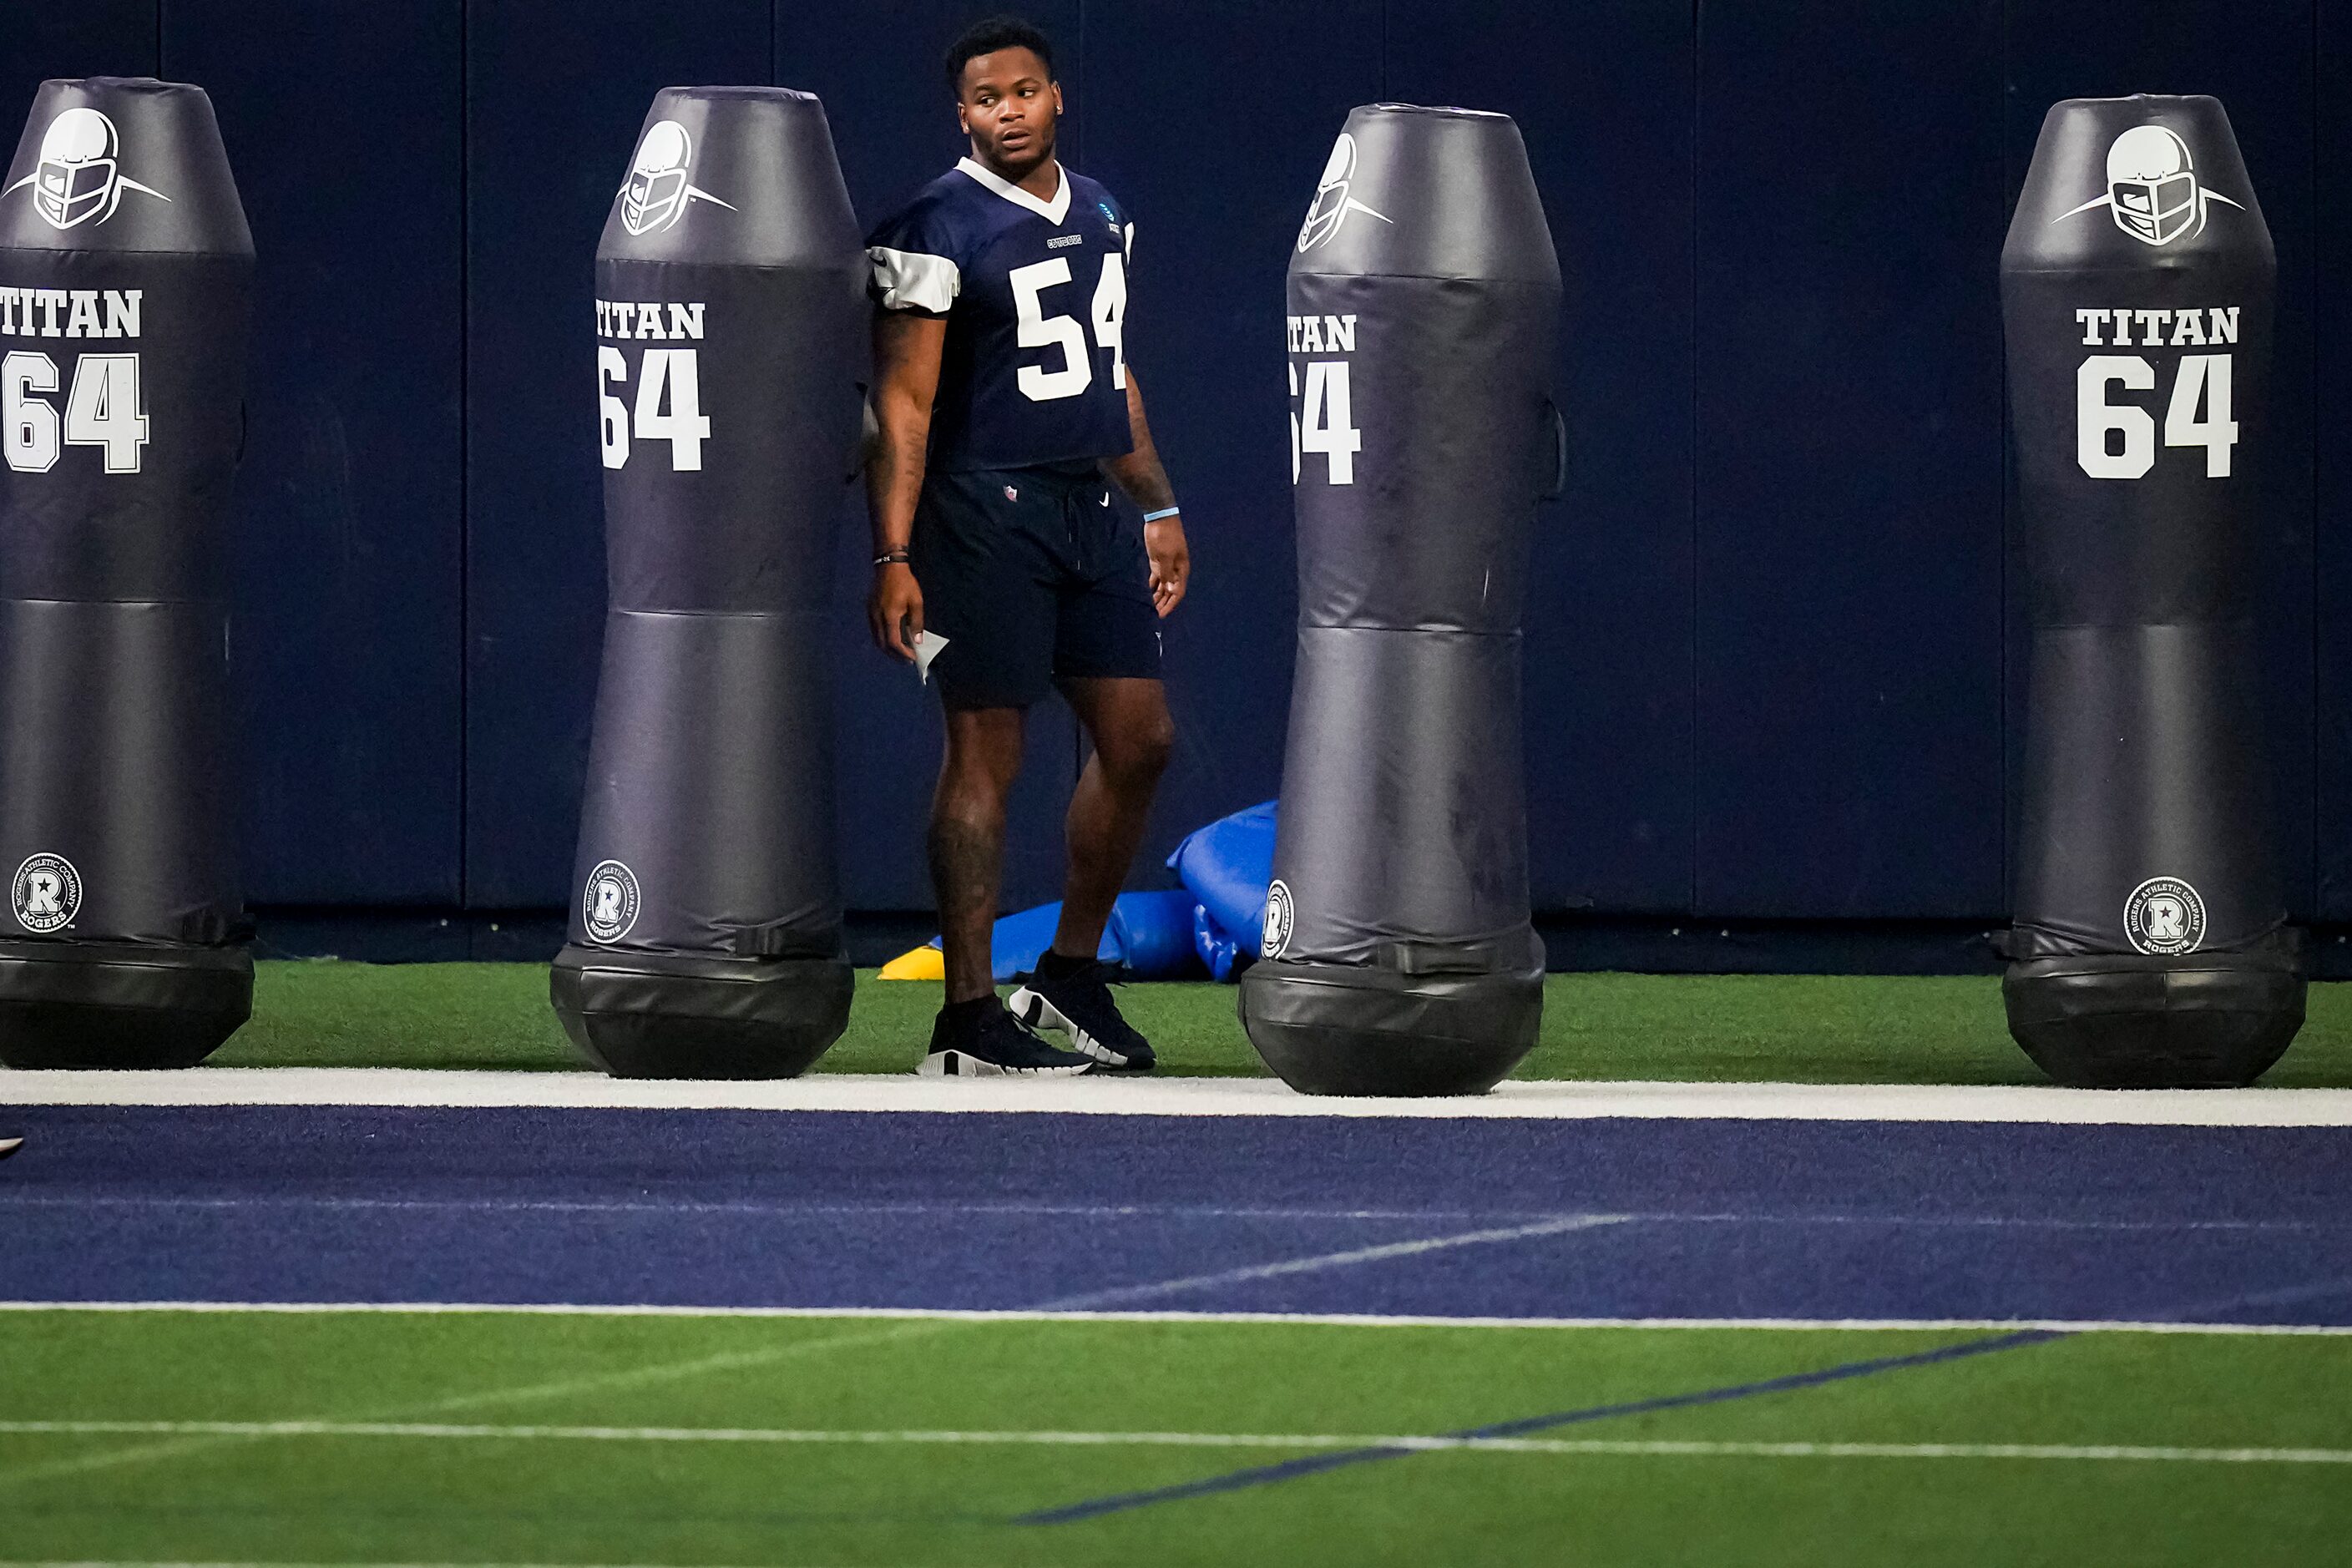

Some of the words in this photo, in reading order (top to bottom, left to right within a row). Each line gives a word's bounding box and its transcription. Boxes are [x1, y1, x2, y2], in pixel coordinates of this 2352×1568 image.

[0, 286, 142, 337] TITAN
[595, 299, 706, 339] TITAN
[1009, 252, 1127, 402] 54
[2076, 306, 2240, 346] TITAN
[2, 350, 150, 474] 64
[597, 345, 711, 471] 64
[2076, 353, 2239, 479] 64
[24, 858, 60, 875] ATHLETIC
[58, 865, 77, 908] COMPANY
[596, 867, 624, 881] ATHLETIC
[623, 877, 635, 918] COMPANY
[2131, 898, 2142, 933] ROGERS
[2141, 883, 2183, 900] ATHLETIC
[2182, 892, 2200, 933] COMPANY
[20, 909, 67, 928] ROGERS
[589, 920, 621, 937] ROGERS
[2142, 939, 2190, 953] ROGERS
